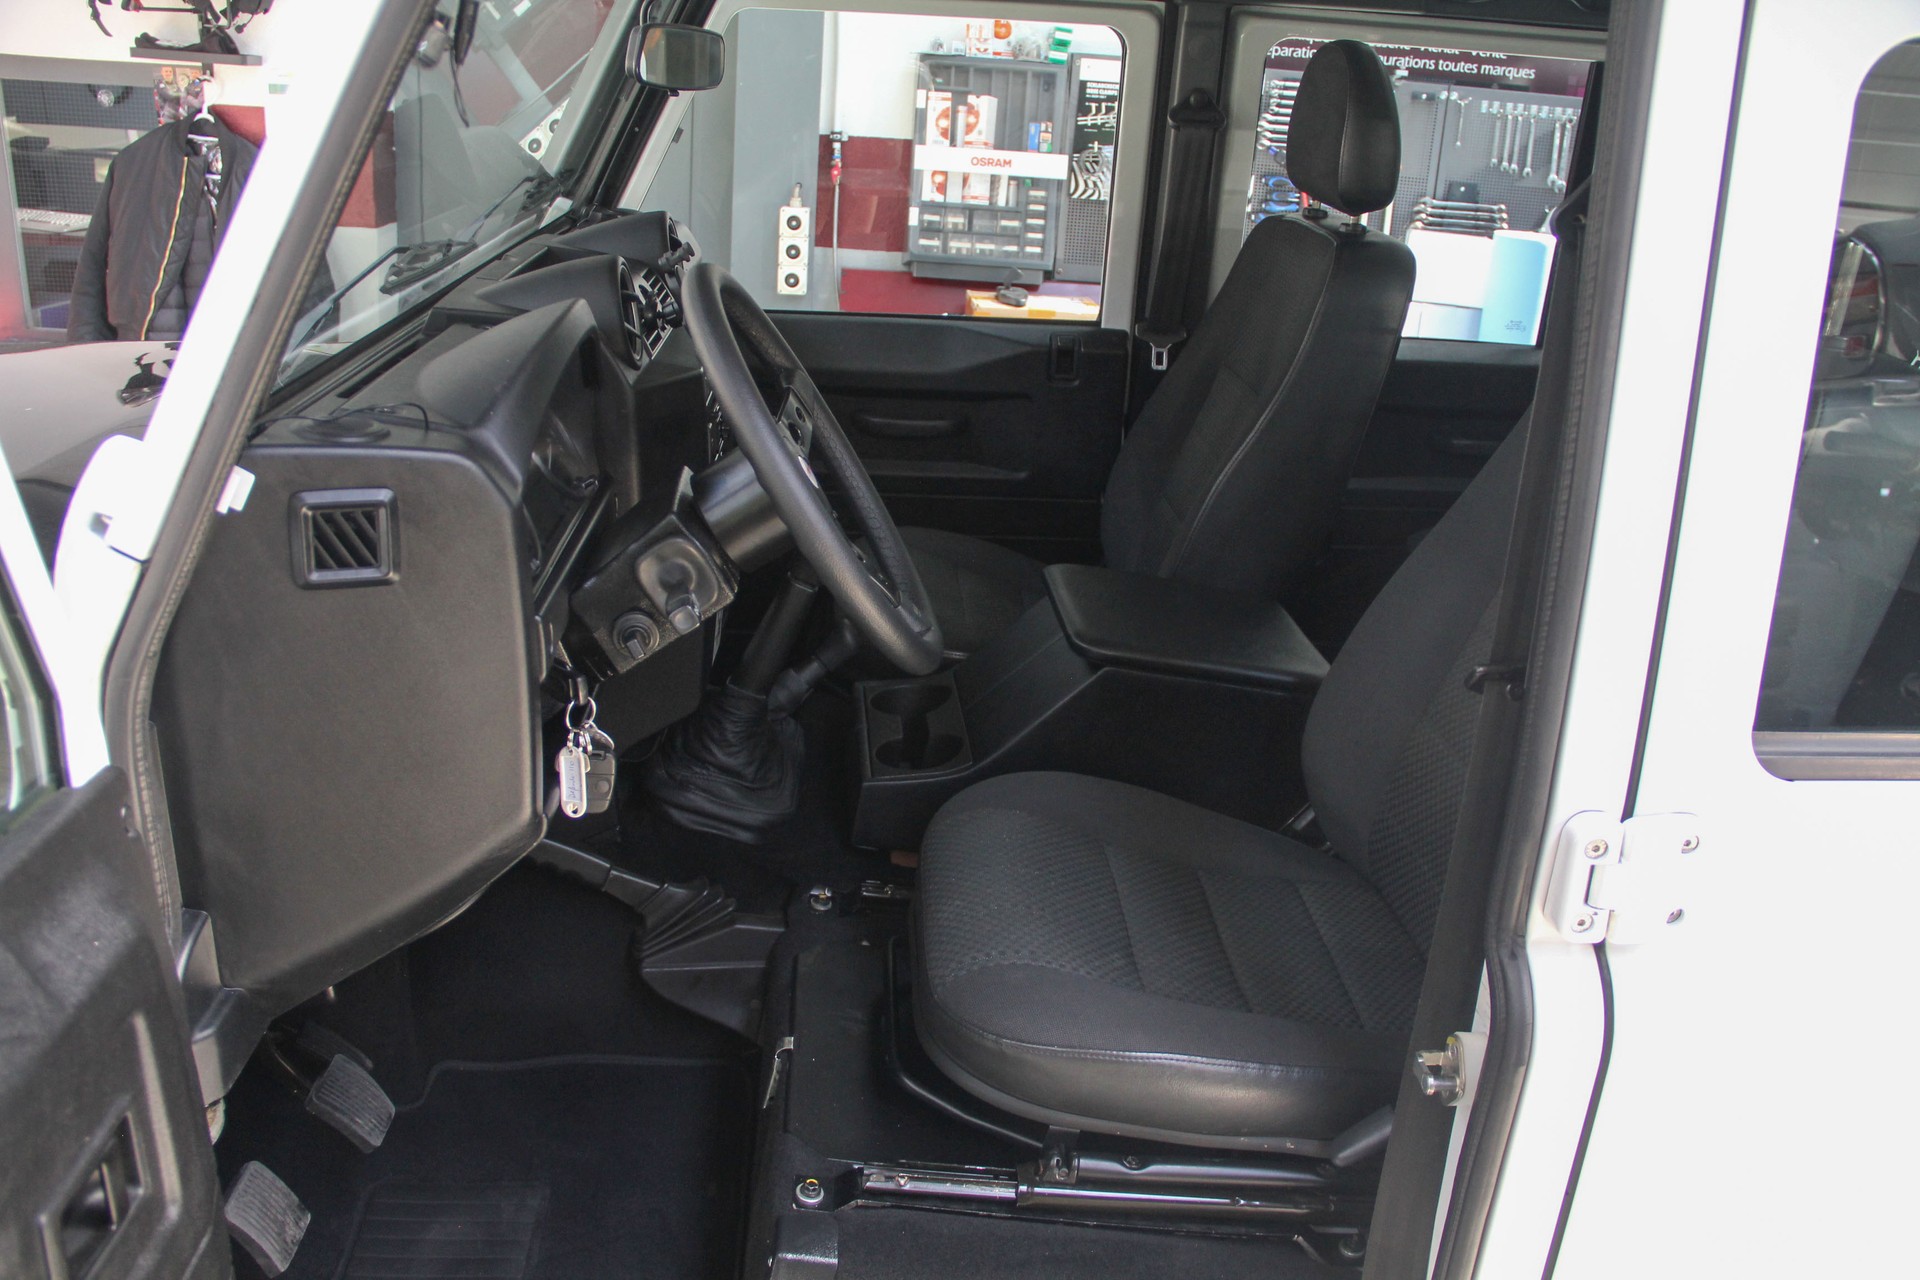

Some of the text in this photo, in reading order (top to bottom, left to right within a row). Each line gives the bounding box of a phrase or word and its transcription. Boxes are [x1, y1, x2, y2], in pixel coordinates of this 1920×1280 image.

[1438, 59, 1479, 74] toutes
[1481, 64, 1536, 80] marques
[971, 156, 1012, 168] OSRAM
